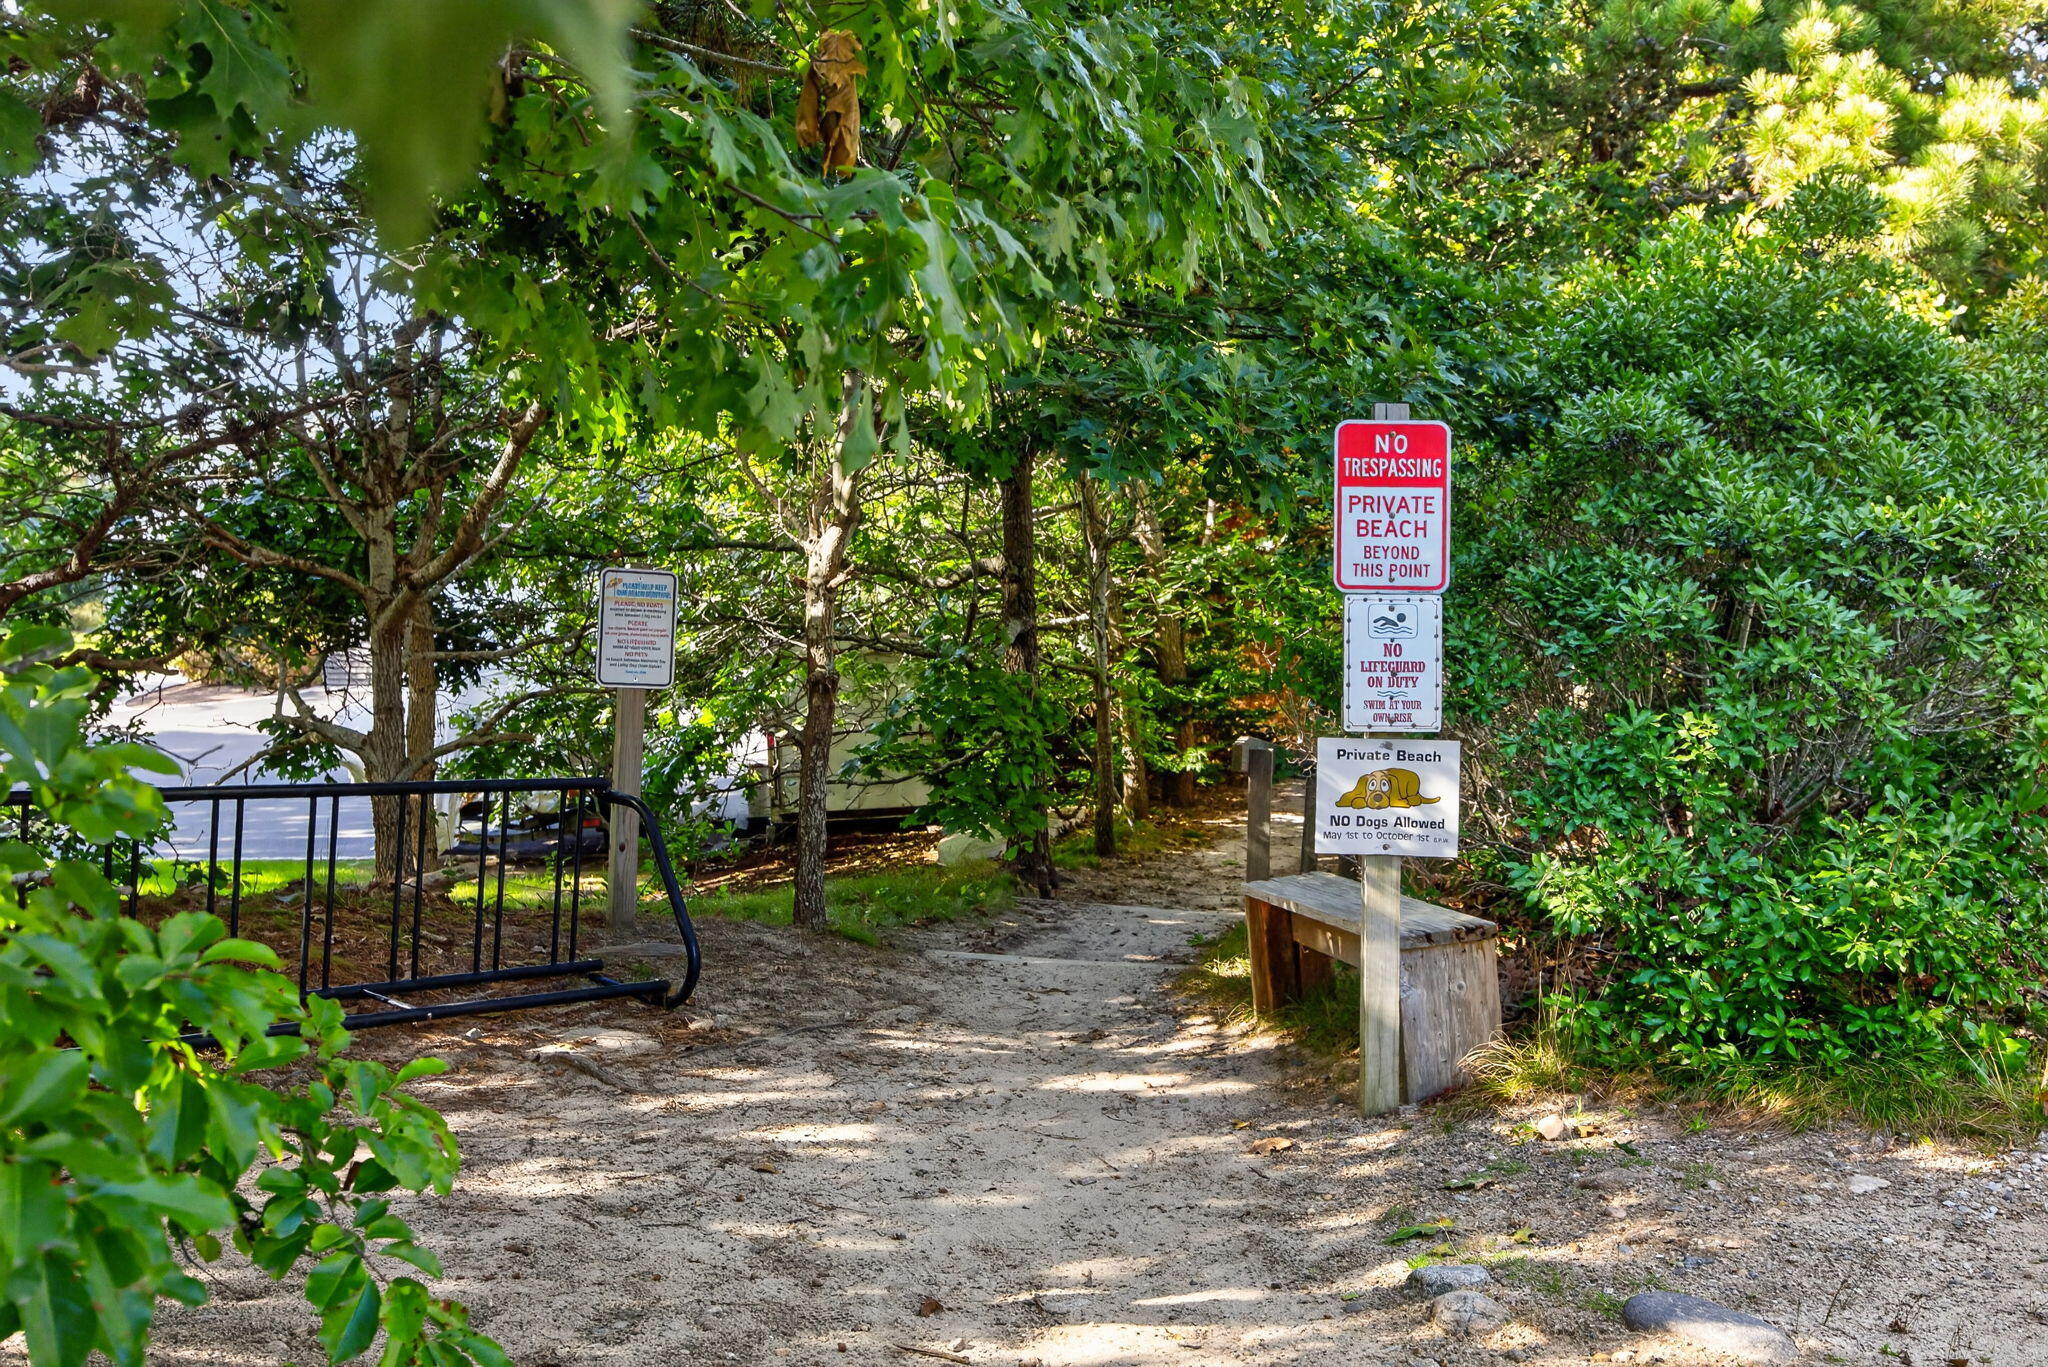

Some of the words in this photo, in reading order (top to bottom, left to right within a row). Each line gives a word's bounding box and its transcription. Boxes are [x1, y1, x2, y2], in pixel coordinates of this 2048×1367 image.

[1375, 434, 1408, 454] NO
[1344, 458, 1441, 478] TRESPASSING
[1349, 496, 1435, 514] PRIVATE
[1357, 520, 1427, 538] BEACH
[1364, 546, 1420, 560] BEYOND
[1353, 564, 1383, 577] THIS
[1389, 564, 1430, 578] POINT
[1383, 643, 1403, 657] NO
[1360, 661, 1425, 673] LIFEGUARD
[1368, 676, 1382, 688] ON
[1388, 677, 1419, 688] DUTY
[1364, 700, 1385, 709] SWIM
[1389, 701, 1400, 709] AT
[1401, 701, 1422, 709] YOUR
[1373, 713, 1390, 722] OWN
[1394, 713, 1412, 722] RISK
[1337, 749, 1390, 760] Private
[1397, 750, 1441, 762] Beach
[1330, 815, 1350, 826] NO
[1357, 816, 1388, 829] Dogs
[1394, 817, 1445, 829] Allowed
[1323, 831, 1341, 840] May
[1377, 832, 1413, 841] October
[1417, 834, 1429, 842] 1st
